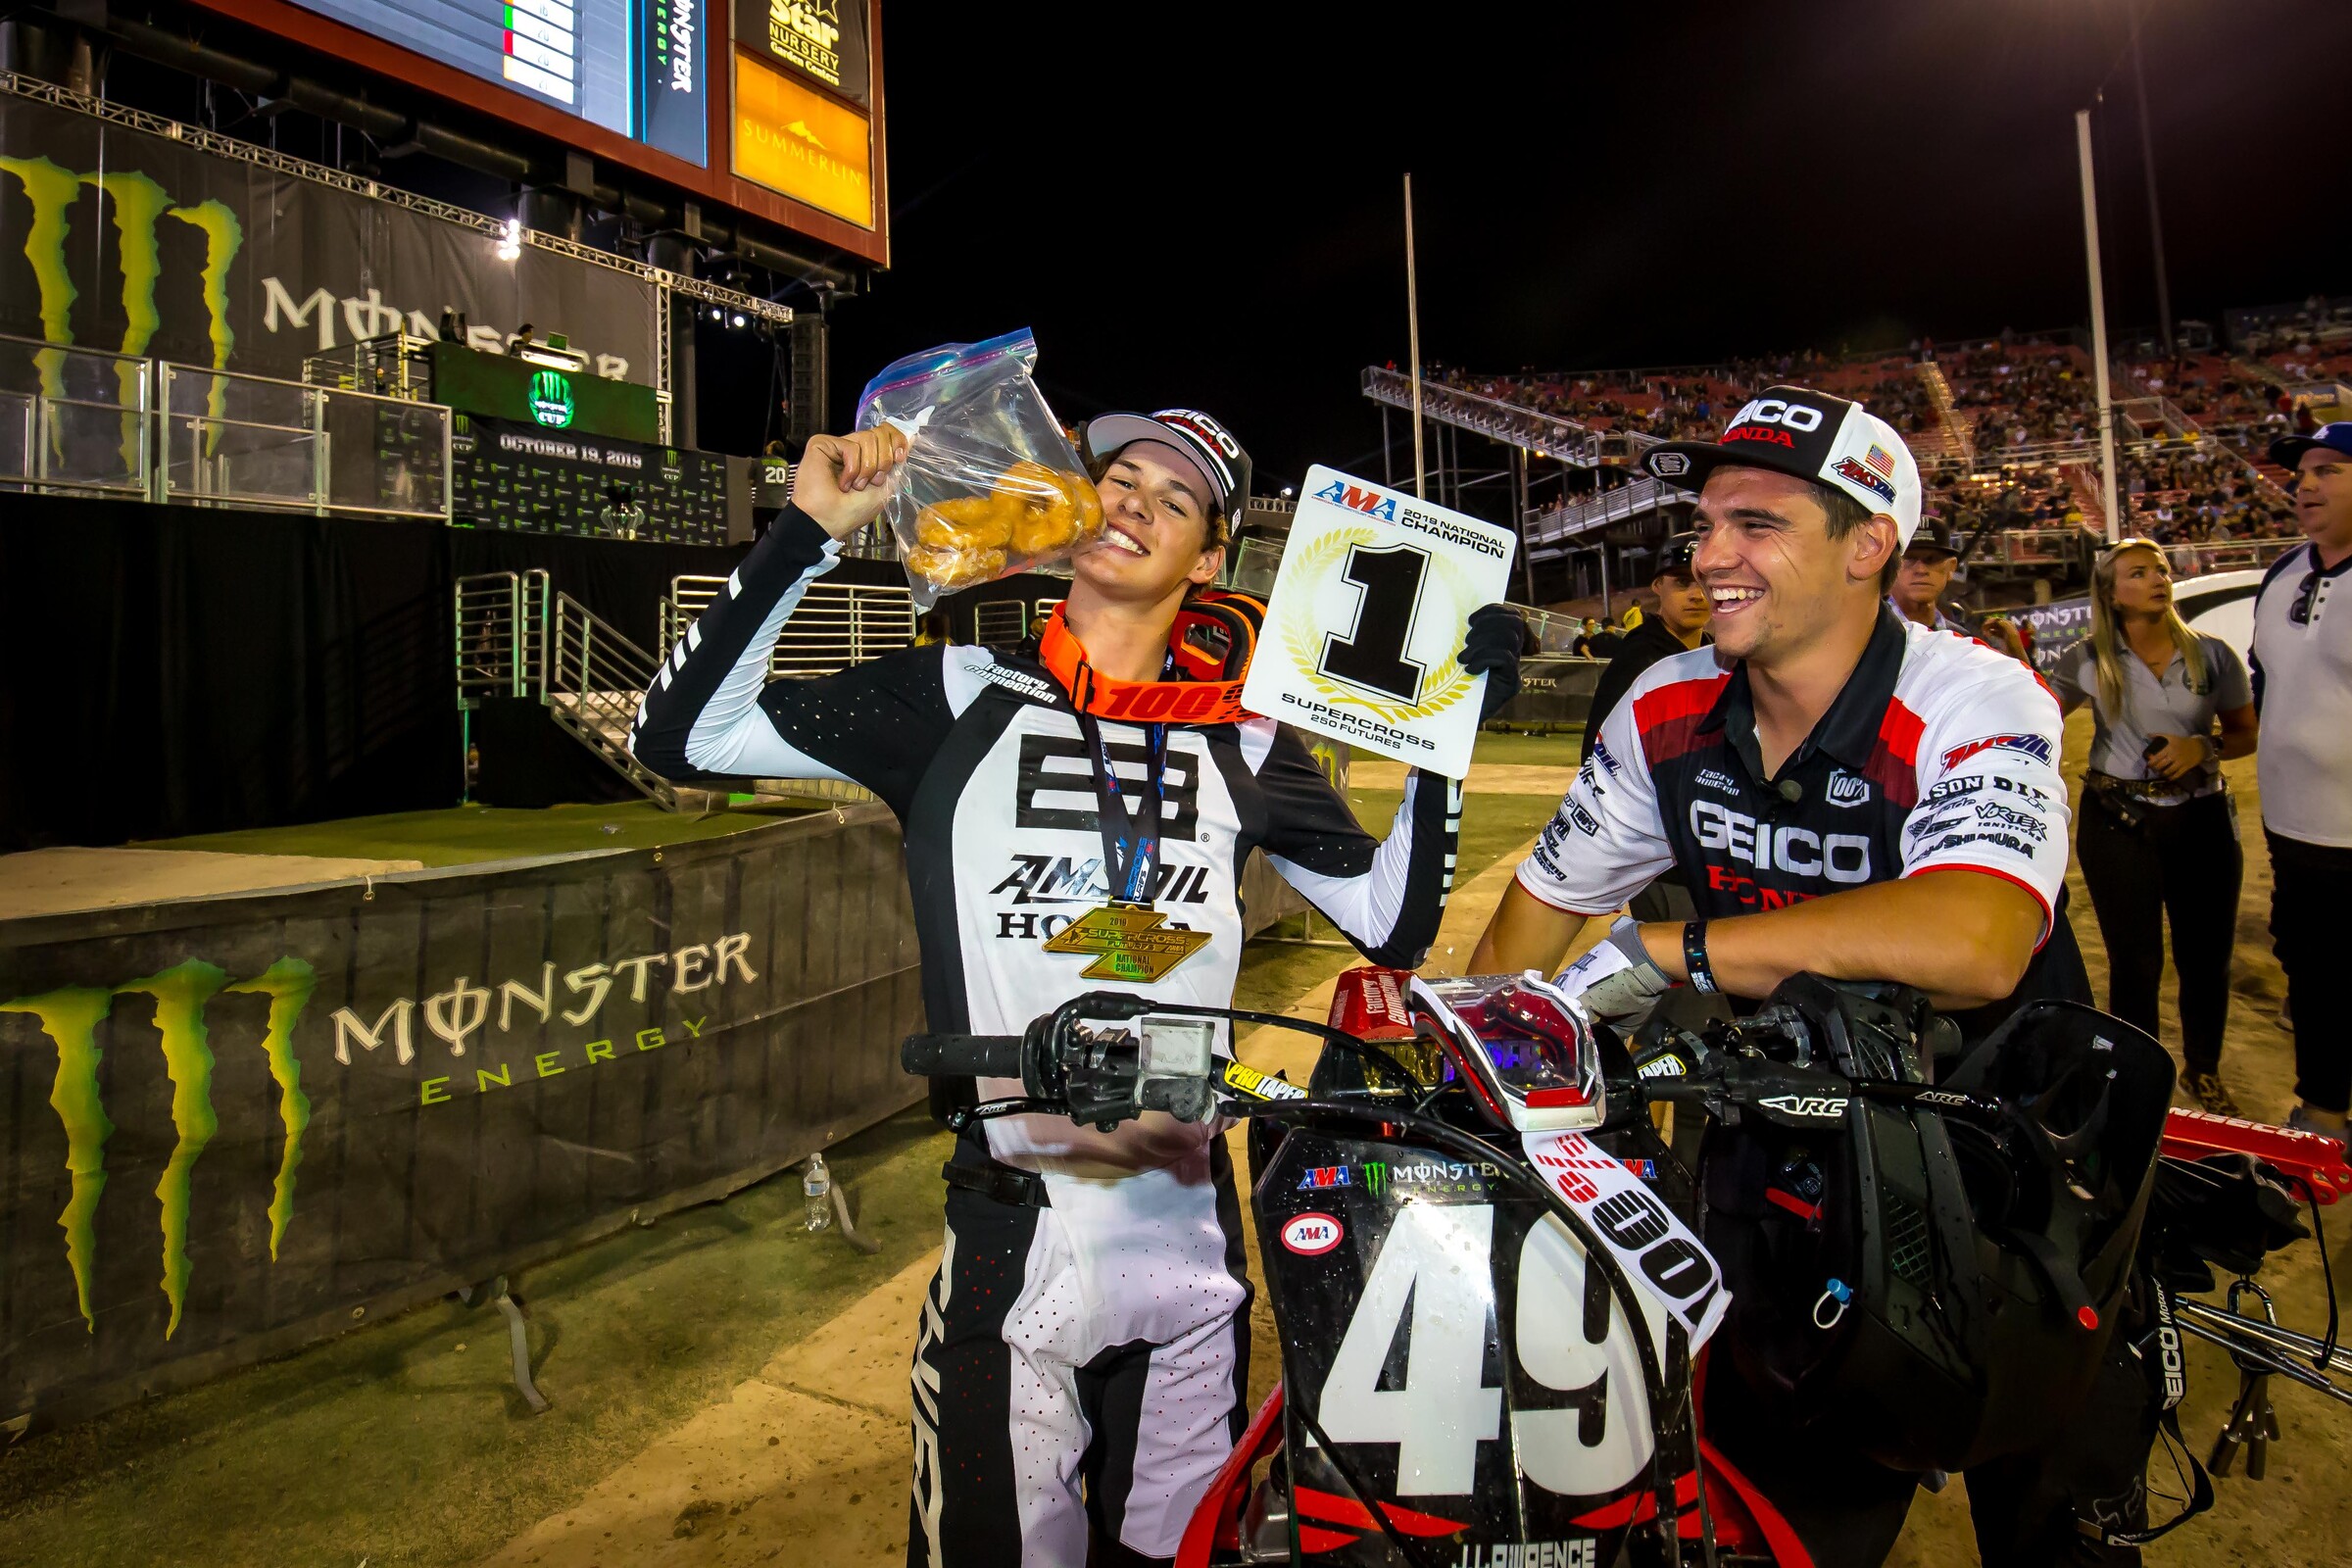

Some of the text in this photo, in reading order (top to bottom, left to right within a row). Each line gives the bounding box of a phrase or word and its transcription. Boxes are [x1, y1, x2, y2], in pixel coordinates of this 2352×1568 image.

[769, 22, 839, 72] NURSERY
[769, 41, 840, 86] Garden Centers
[743, 120, 862, 187] SUMMERLIN
[500, 433, 643, 469] OCTOBER 19, 2019
[765, 466, 786, 483] 20
[1312, 480, 1396, 522] AMA
[1400, 516, 1504, 560] CHAMPION
[1403, 509, 1506, 550] 2019 NATIONAL
[1316, 542, 1432, 708] 1
[984, 662, 1051, 690] Factory
[1520, 675, 1557, 688] STER
[1281, 693, 1436, 751] SUPERCROSS
[1310, 713, 1401, 750] 250 FUTURES
[1976, 803, 2048, 841] VORTEX
[1978, 822, 2042, 842] IGNITIONS
[1690, 800, 1871, 883] GEICO
[1114, 963, 1154, 974] CHAMPION
[1115, 954, 1151, 965] NATIONAL
[330, 932, 759, 1065] MONSTER
[1361, 978, 1387, 1014] Factory
[421, 1016, 707, 1104] ENERGY
[1758, 1095, 1849, 1117] ARC
[1915, 1091, 1967, 1106] ARC
[1297, 1165, 1351, 1190] AMA
[1616, 1158, 1658, 1179] MA
[1413, 1183, 1496, 1194] ENERGY
[1294, 1226, 1330, 1242] AMA
[1305, 1204, 1666, 1496] 49
